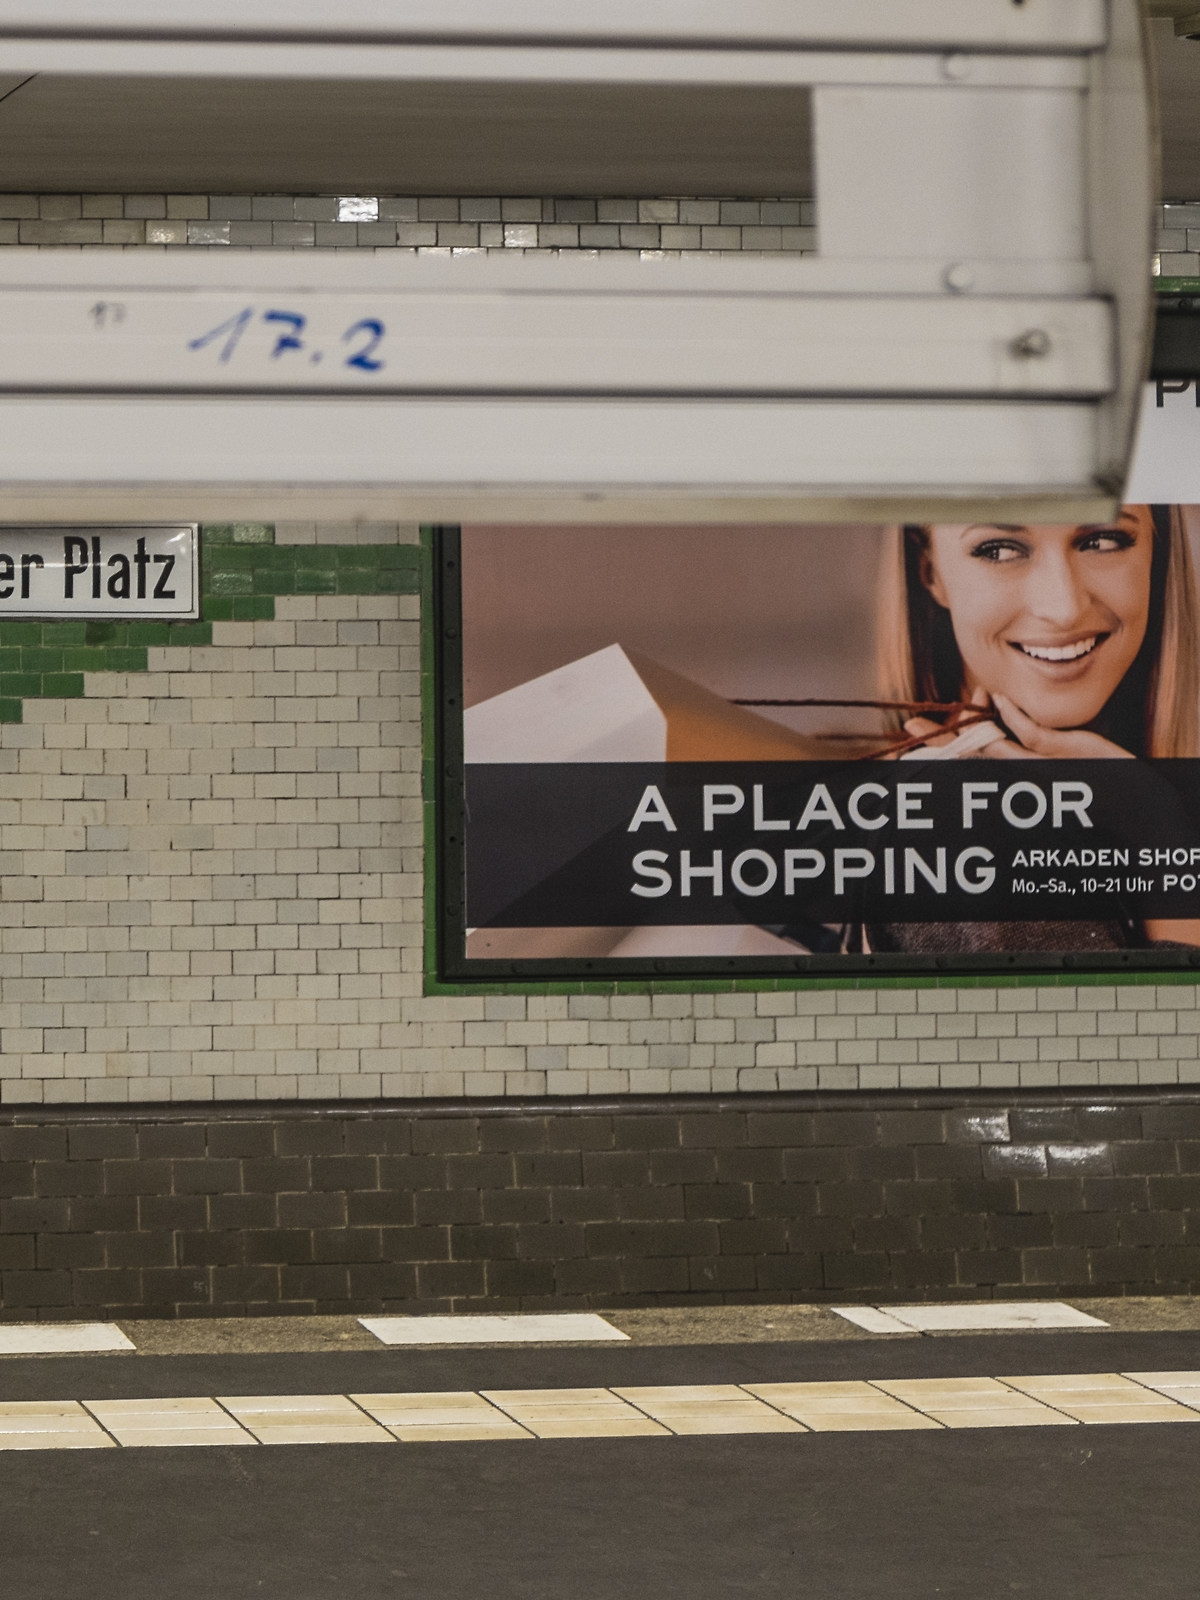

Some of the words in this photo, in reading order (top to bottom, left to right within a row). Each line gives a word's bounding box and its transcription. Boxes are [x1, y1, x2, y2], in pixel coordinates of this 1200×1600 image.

[63, 535, 176, 600] Platz
[627, 784, 677, 832] A
[703, 782, 934, 831] PLACE
[962, 781, 1094, 829] FOR
[630, 846, 997, 898] SHOPPING
[1011, 848, 1130, 867] ARKADEN
[1126, 876, 1154, 893] Uhr
[1163, 874, 1200, 892] PO
